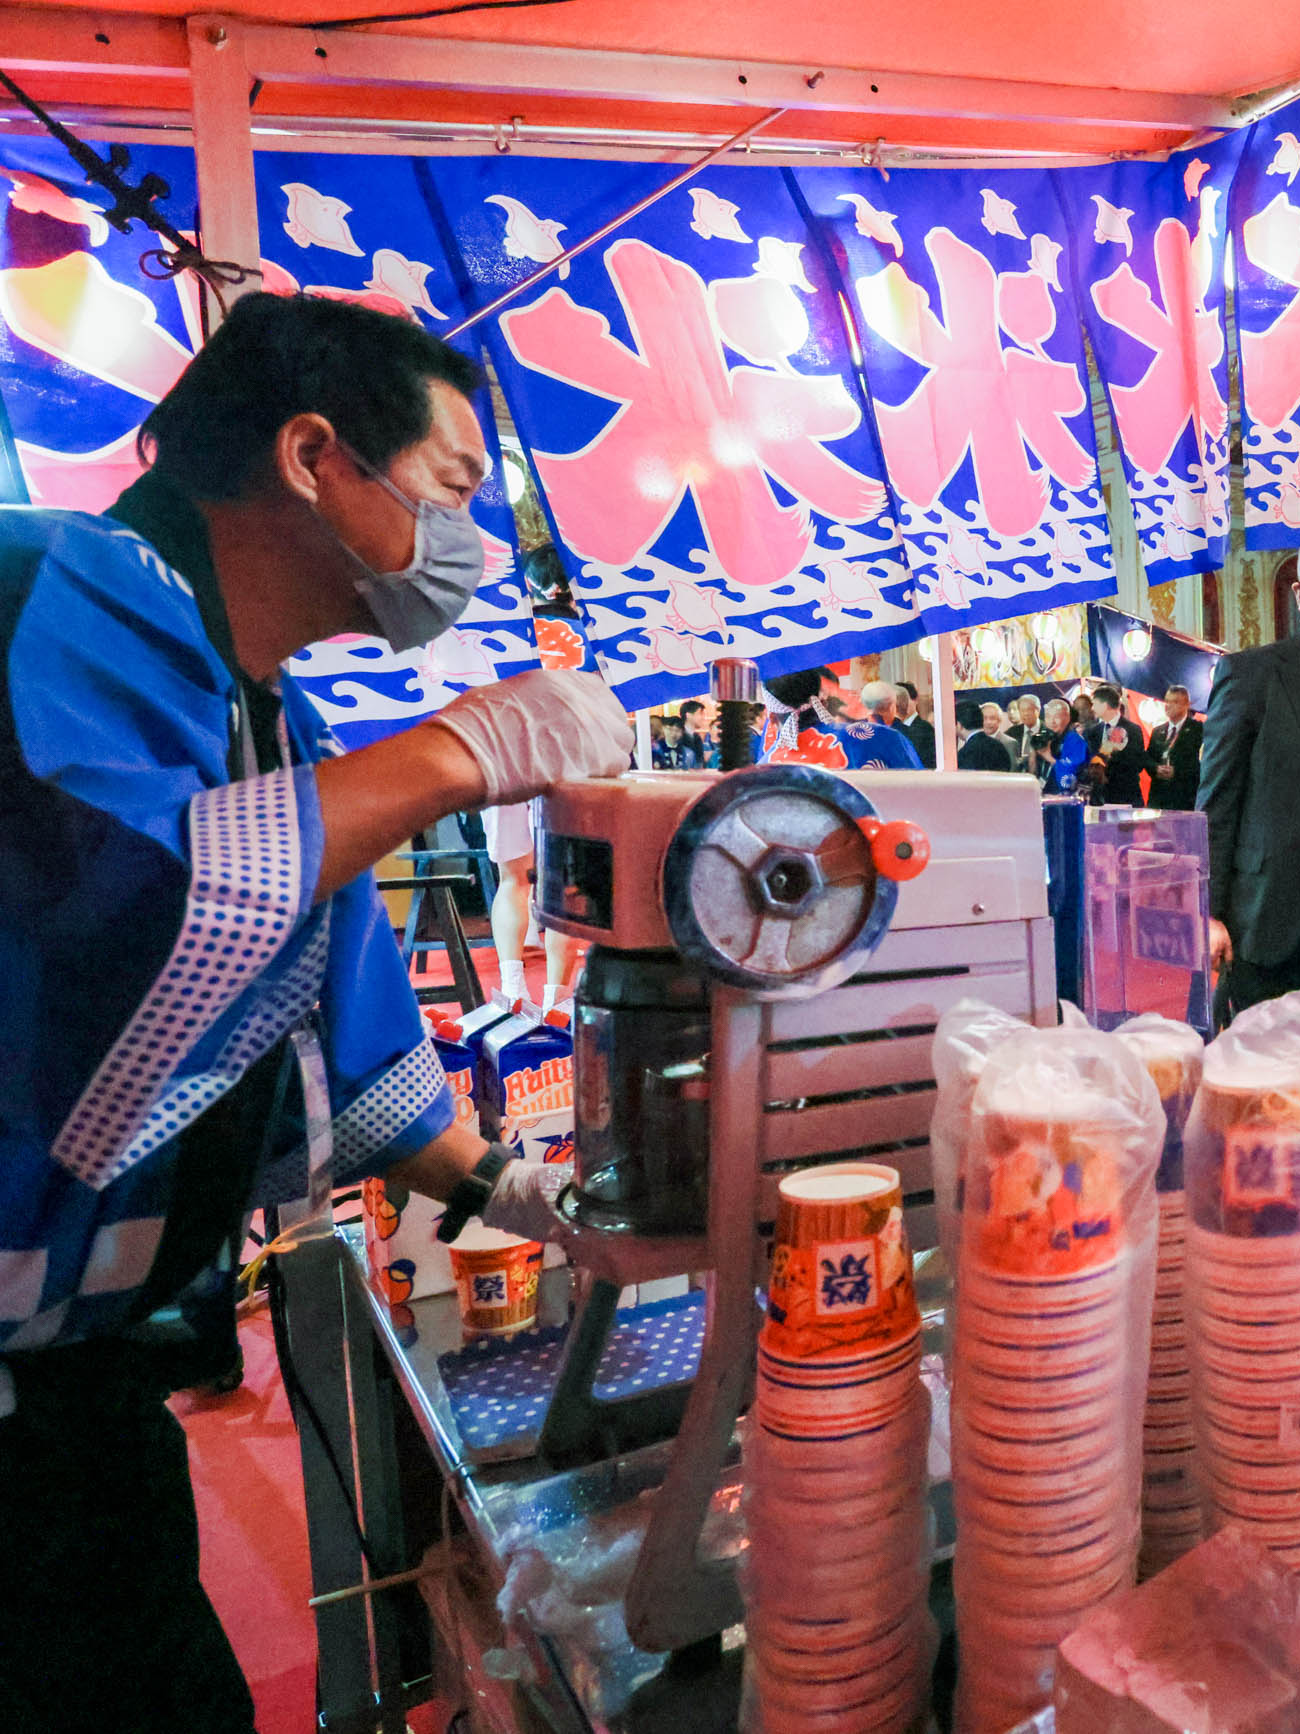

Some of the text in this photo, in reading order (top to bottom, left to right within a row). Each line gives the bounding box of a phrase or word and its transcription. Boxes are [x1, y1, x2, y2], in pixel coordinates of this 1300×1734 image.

[498, 238, 890, 586] 氷
[855, 226, 1098, 538] 氷
[473, 1274, 506, 1303] 祭
